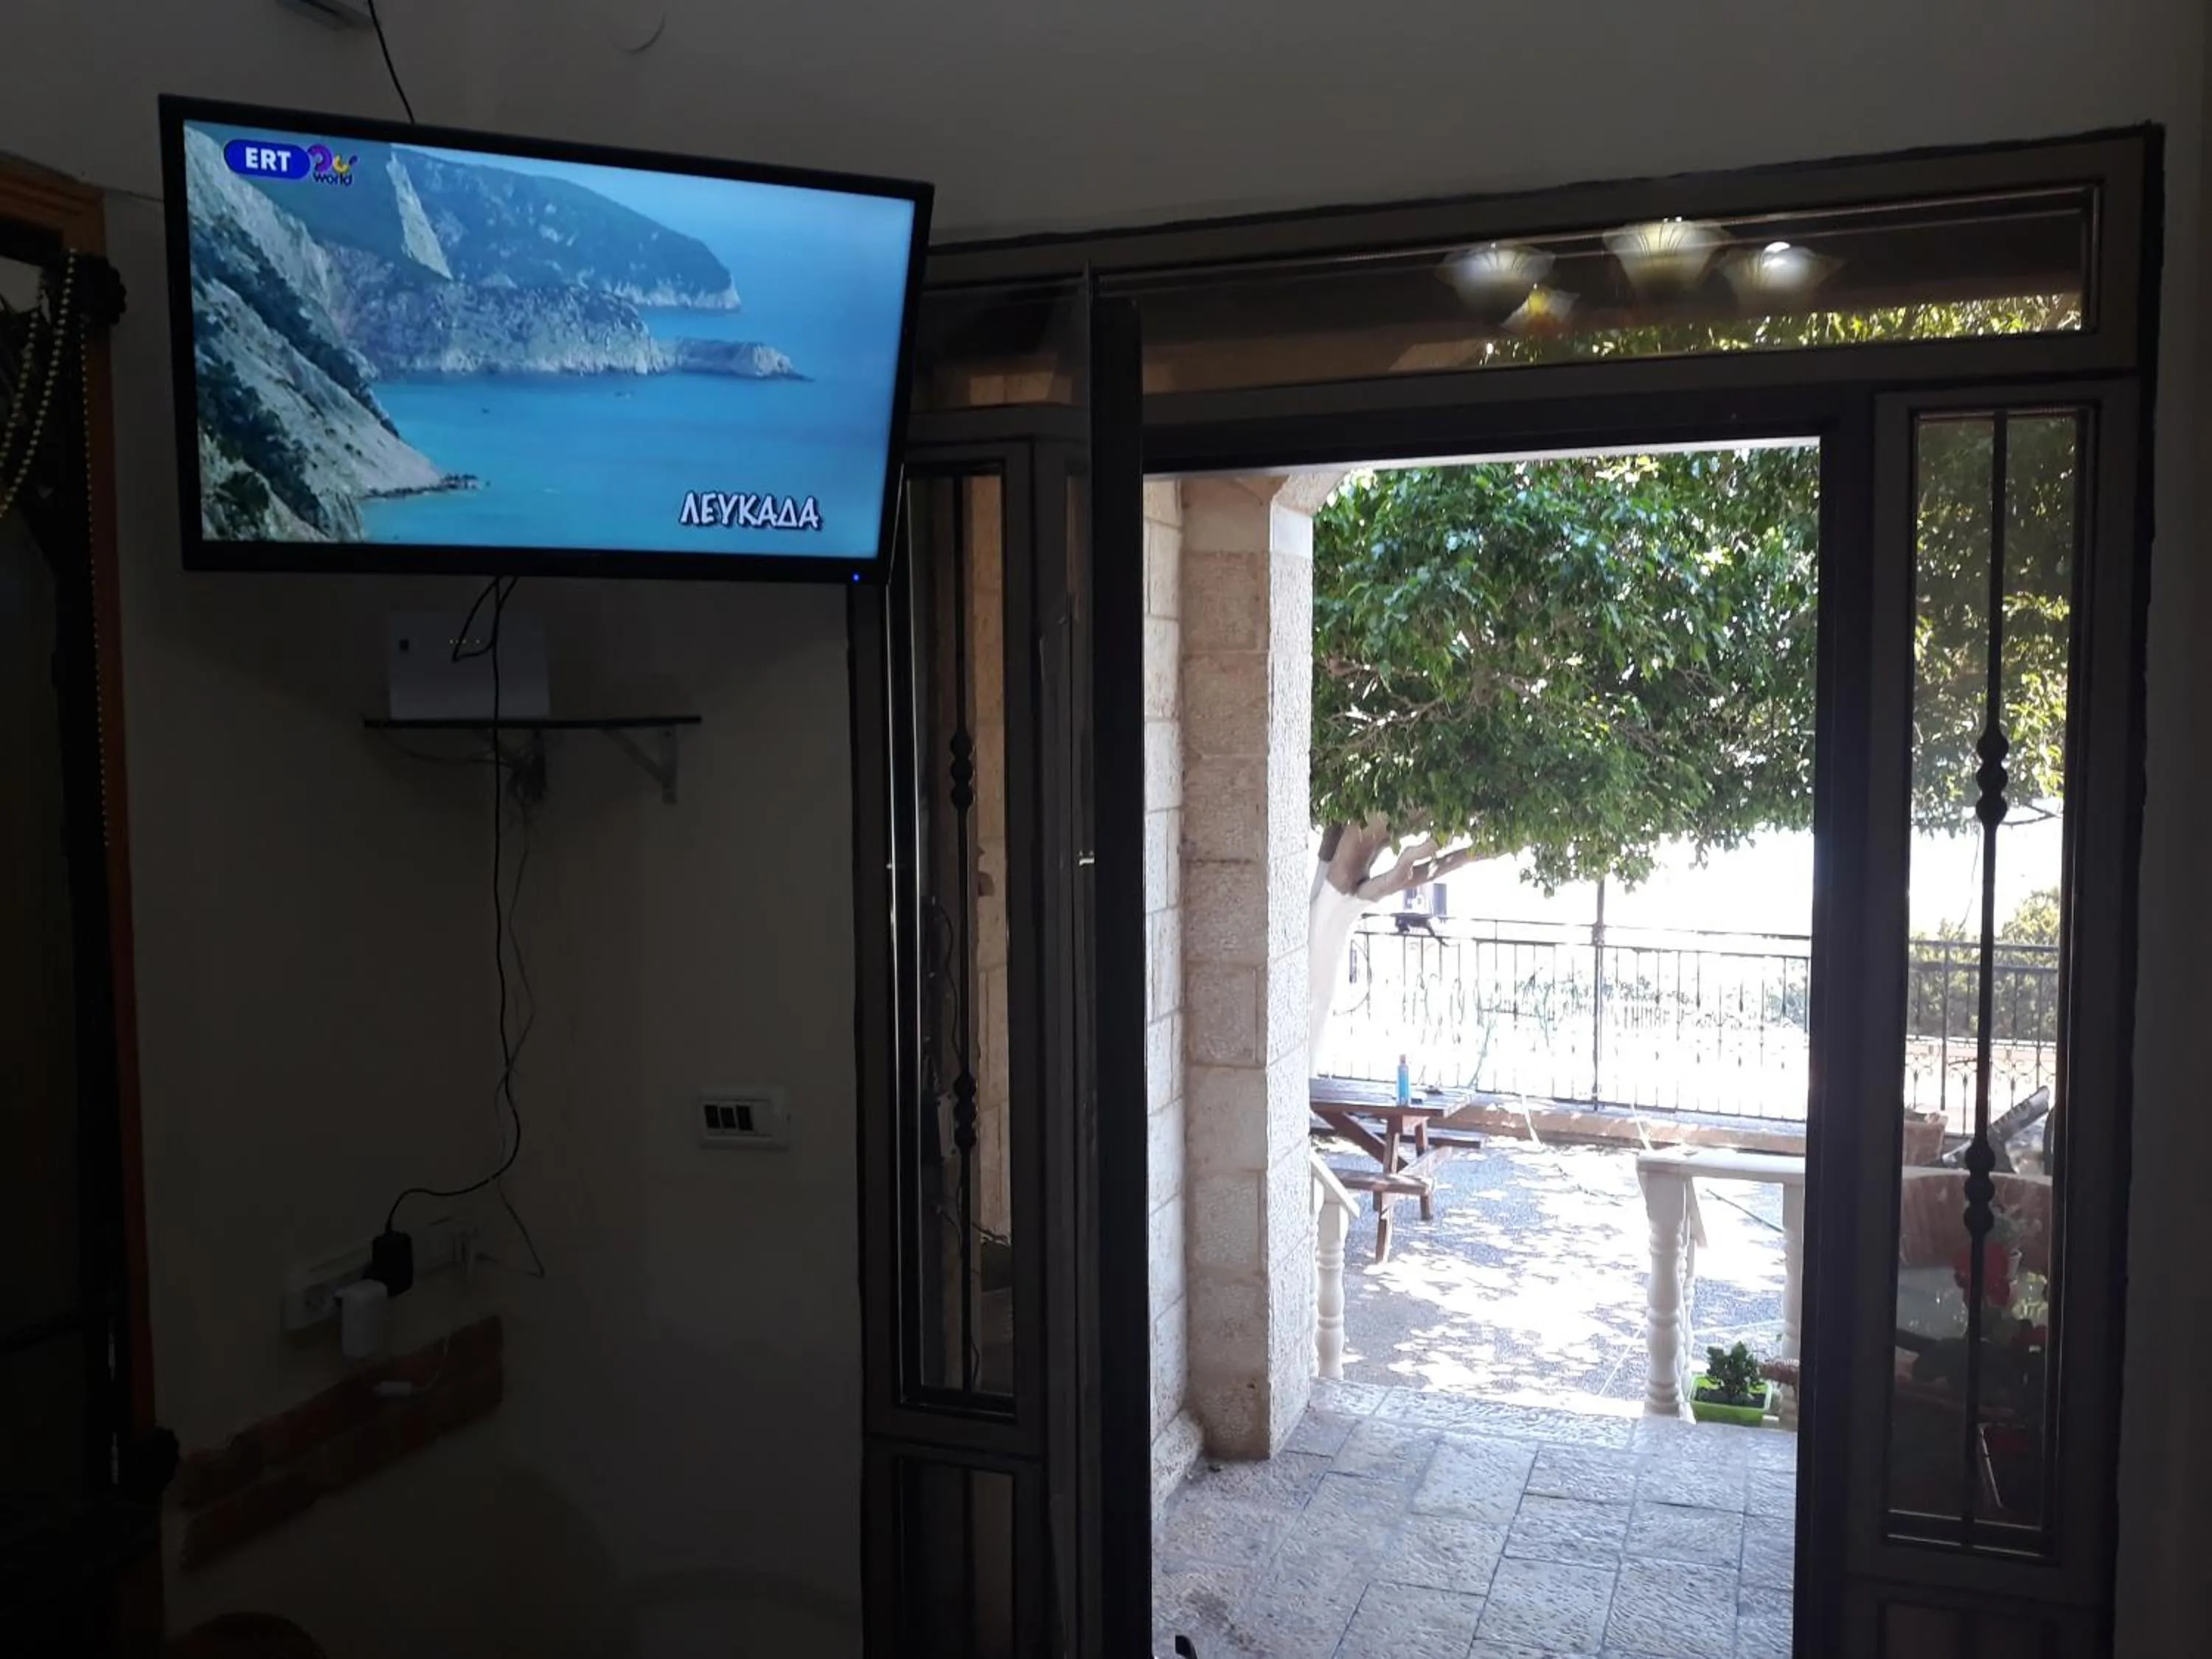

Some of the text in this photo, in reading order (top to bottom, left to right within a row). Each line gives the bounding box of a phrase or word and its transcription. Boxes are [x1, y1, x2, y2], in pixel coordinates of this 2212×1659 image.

[246, 147, 291, 172] ERT
[313, 171, 352, 186] world
[680, 491, 820, 529] ΛΕΥΚΑΔΑ
